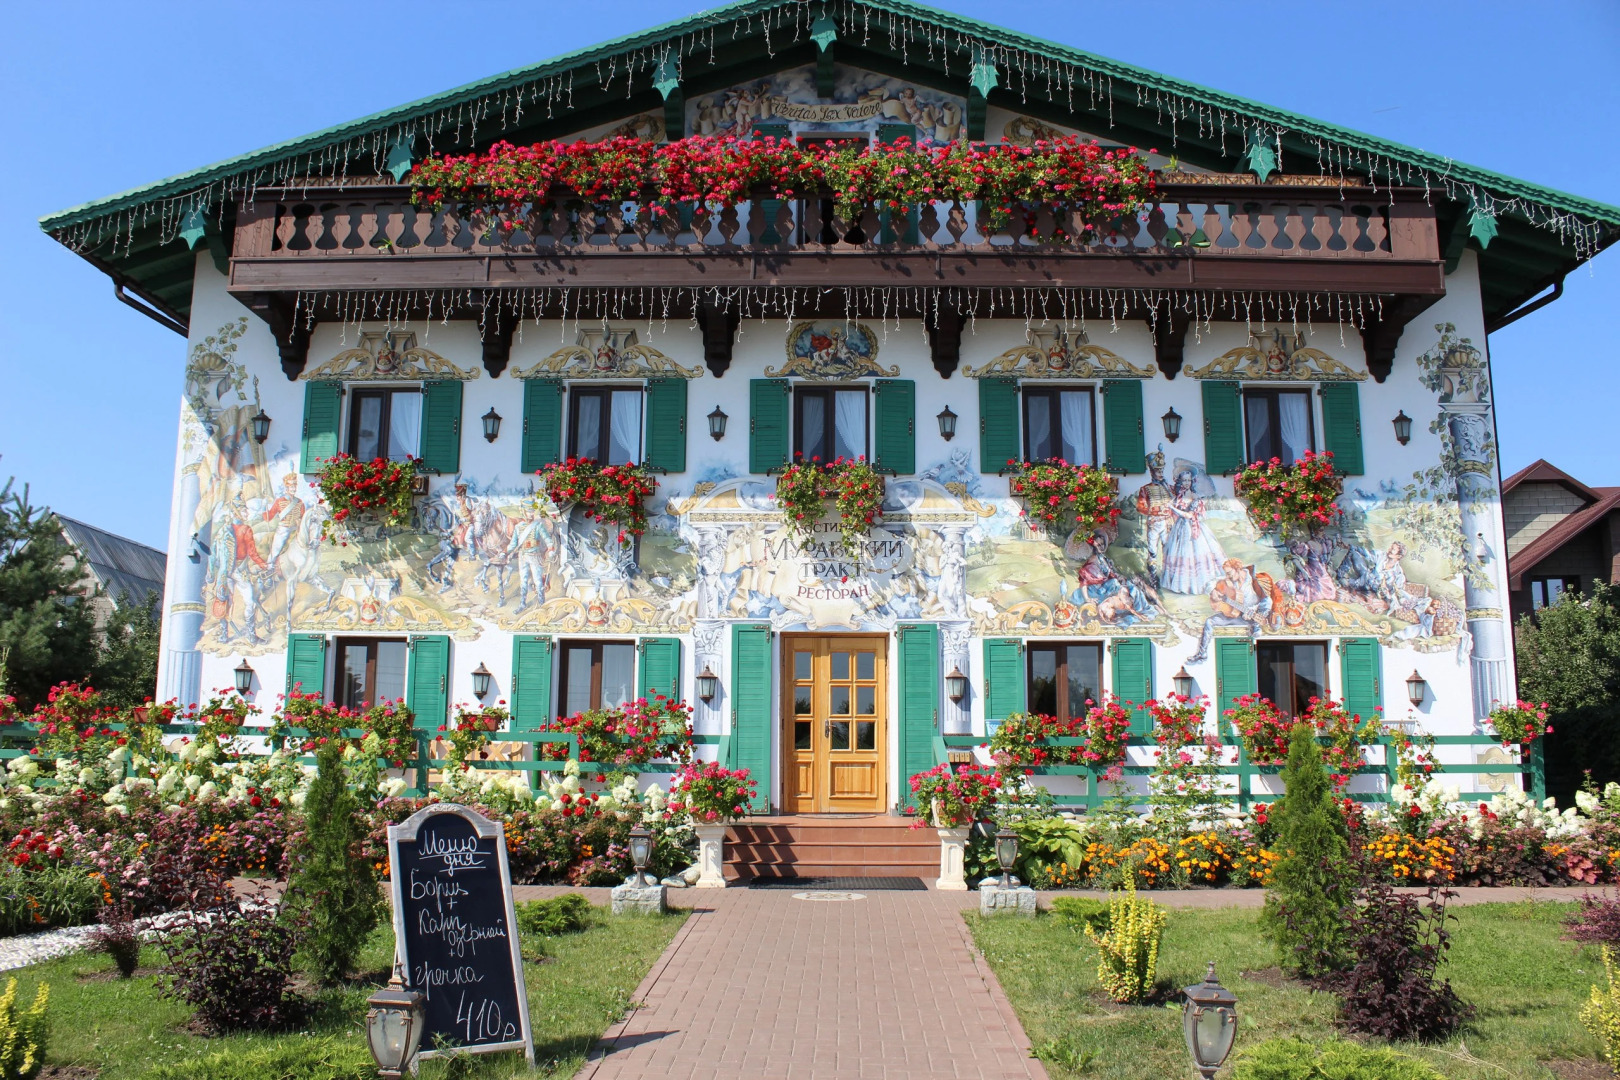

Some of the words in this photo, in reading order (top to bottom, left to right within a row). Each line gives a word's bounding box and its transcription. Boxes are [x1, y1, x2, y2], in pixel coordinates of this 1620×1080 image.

[800, 562, 867, 578] ТРАКТ
[797, 585, 870, 600] РЕСТОРАН
[418, 830, 478, 856] Меню
[443, 853, 485, 877] дня
[411, 868, 469, 913] Борщ
[418, 908, 468, 941] Карп
[415, 961, 485, 1001] гречка
